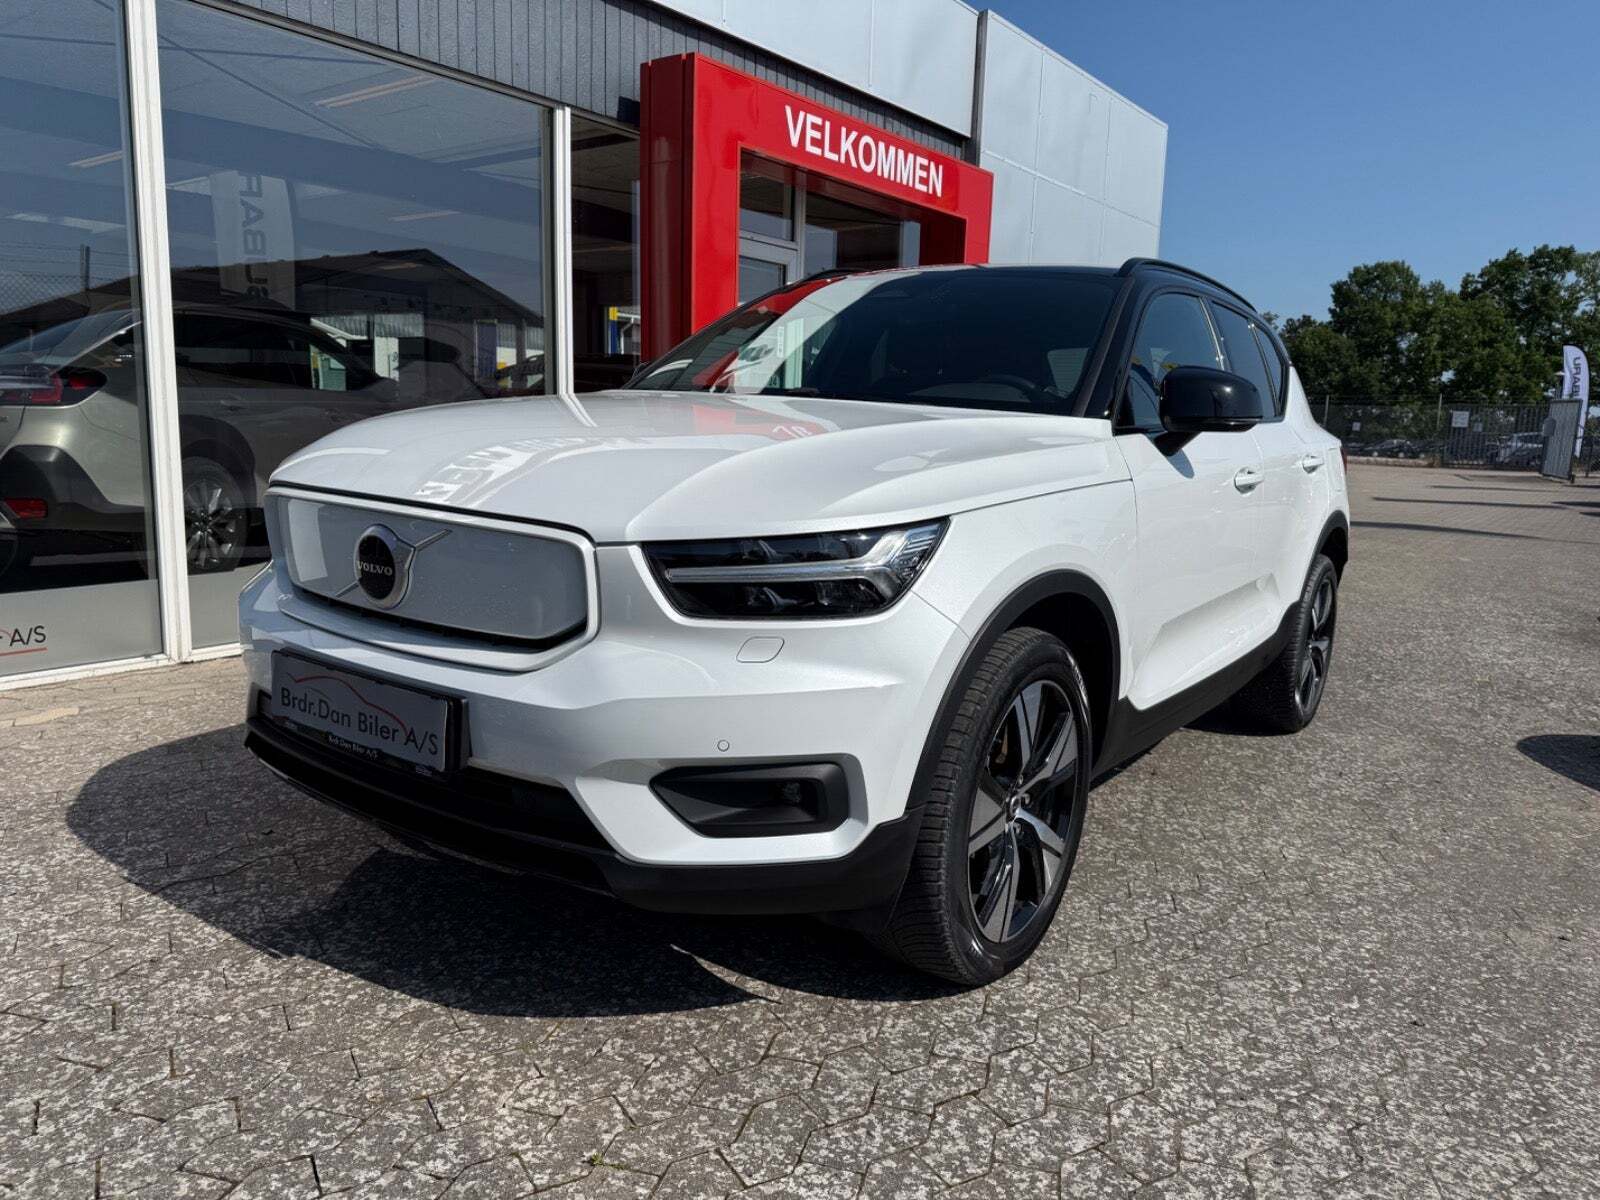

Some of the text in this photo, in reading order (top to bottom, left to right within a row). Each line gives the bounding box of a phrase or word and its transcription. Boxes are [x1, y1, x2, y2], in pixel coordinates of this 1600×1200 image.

[785, 105, 943, 197] VELKOMMEN
[356, 560, 393, 576] VOLVO
[9, 625, 47, 647] A/S
[358, 712, 399, 742] Biler
[404, 727, 438, 756] A/S
